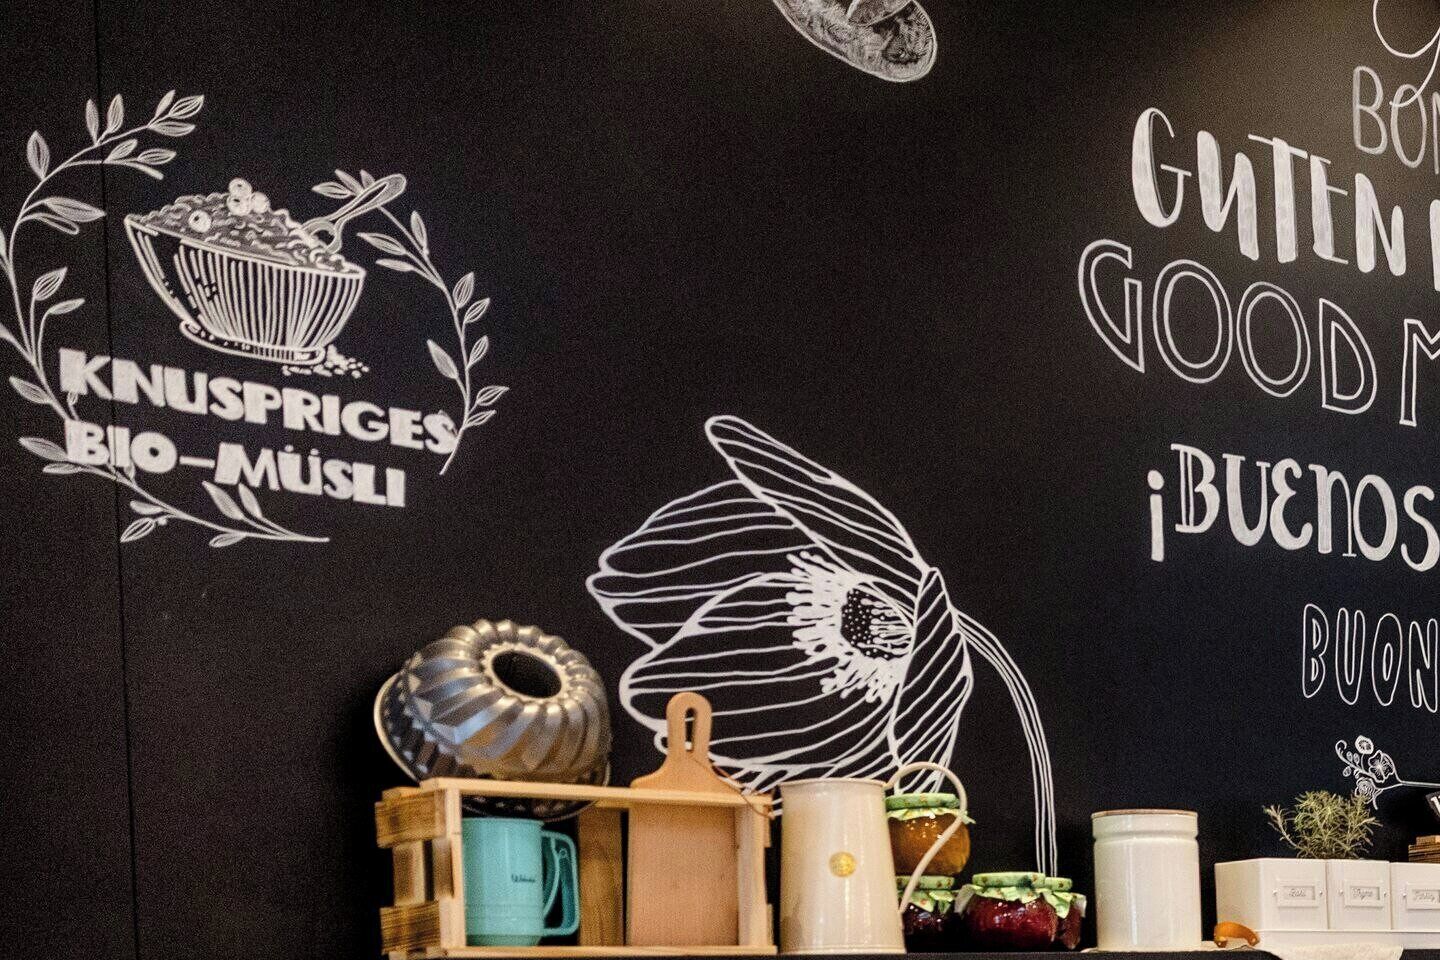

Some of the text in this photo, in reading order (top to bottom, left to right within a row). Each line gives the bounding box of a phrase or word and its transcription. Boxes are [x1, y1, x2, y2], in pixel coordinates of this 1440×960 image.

[1132, 107, 1406, 277] GUTEN
[1078, 239, 1378, 415] GOOD
[58, 347, 460, 456] KNUSPRIGES
[64, 418, 407, 507] BIO-MÜSLI
